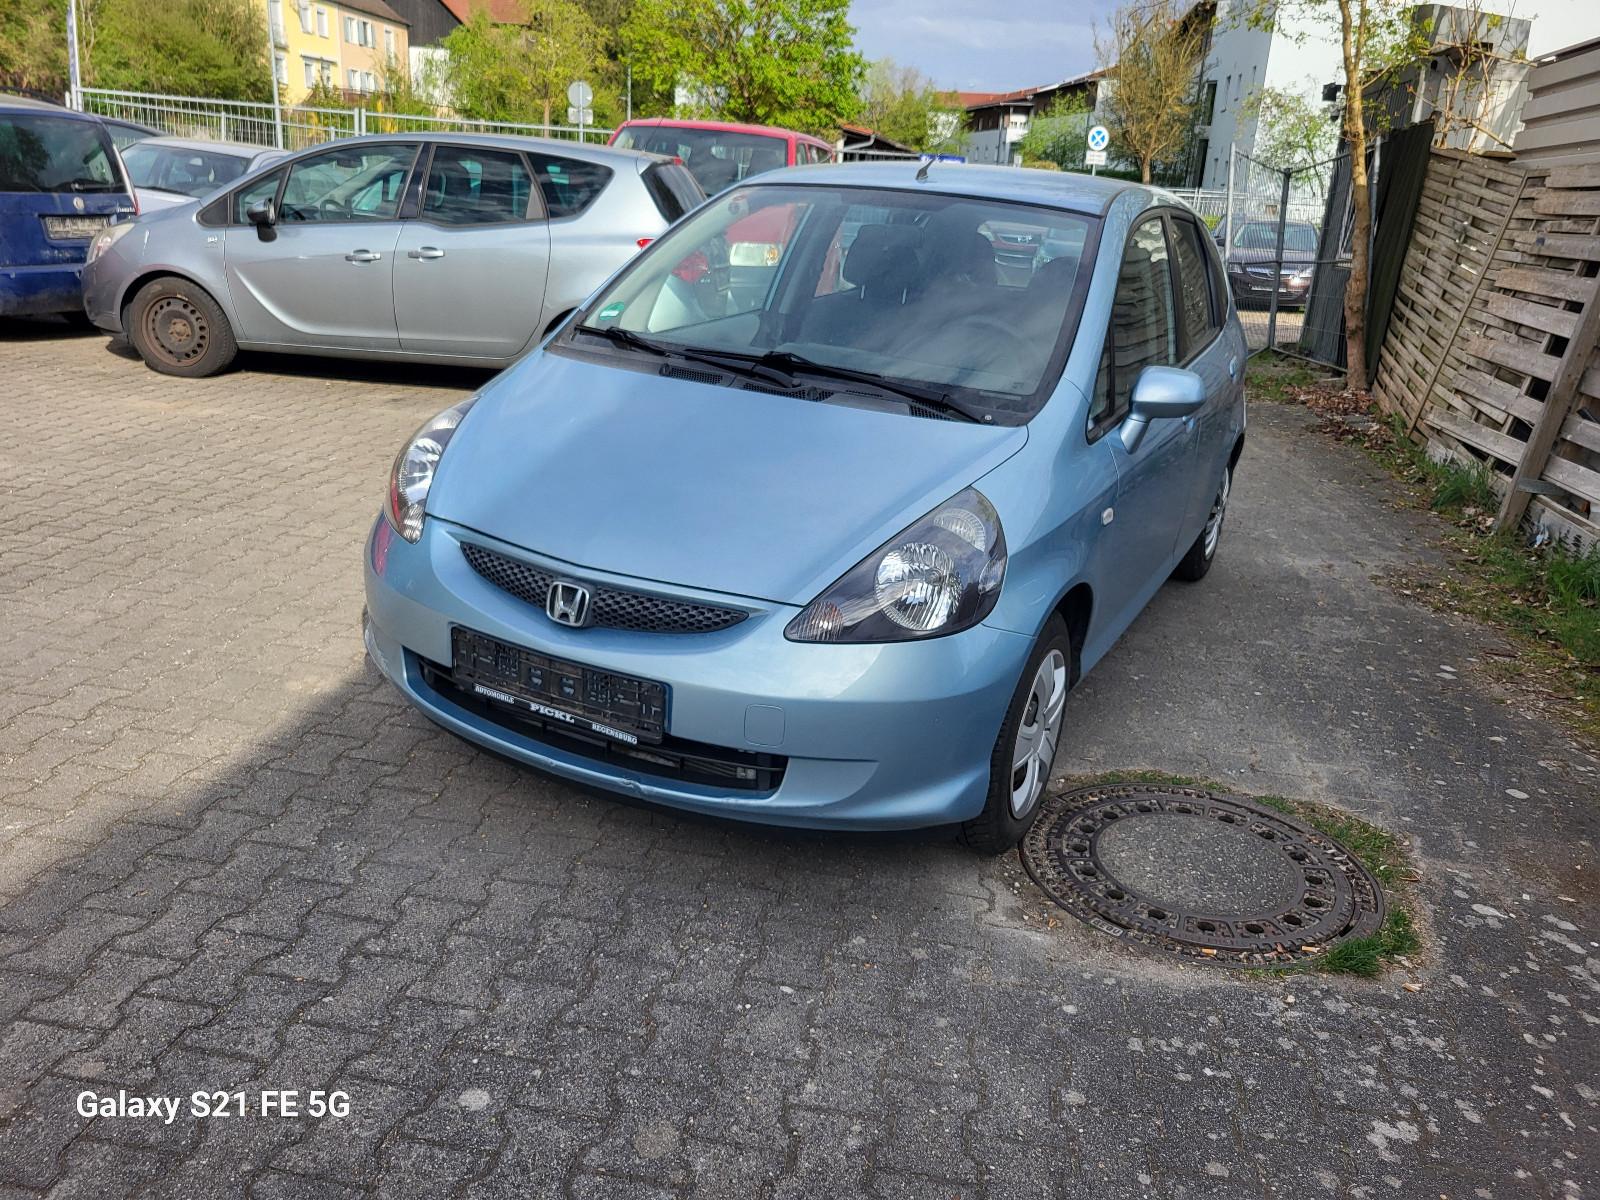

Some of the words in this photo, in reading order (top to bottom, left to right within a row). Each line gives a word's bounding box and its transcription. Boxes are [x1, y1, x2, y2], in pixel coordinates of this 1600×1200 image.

[474, 685, 515, 704] AUTOMOBILE
[529, 702, 575, 724] PICKL
[592, 723, 638, 745] REGENSBURG
